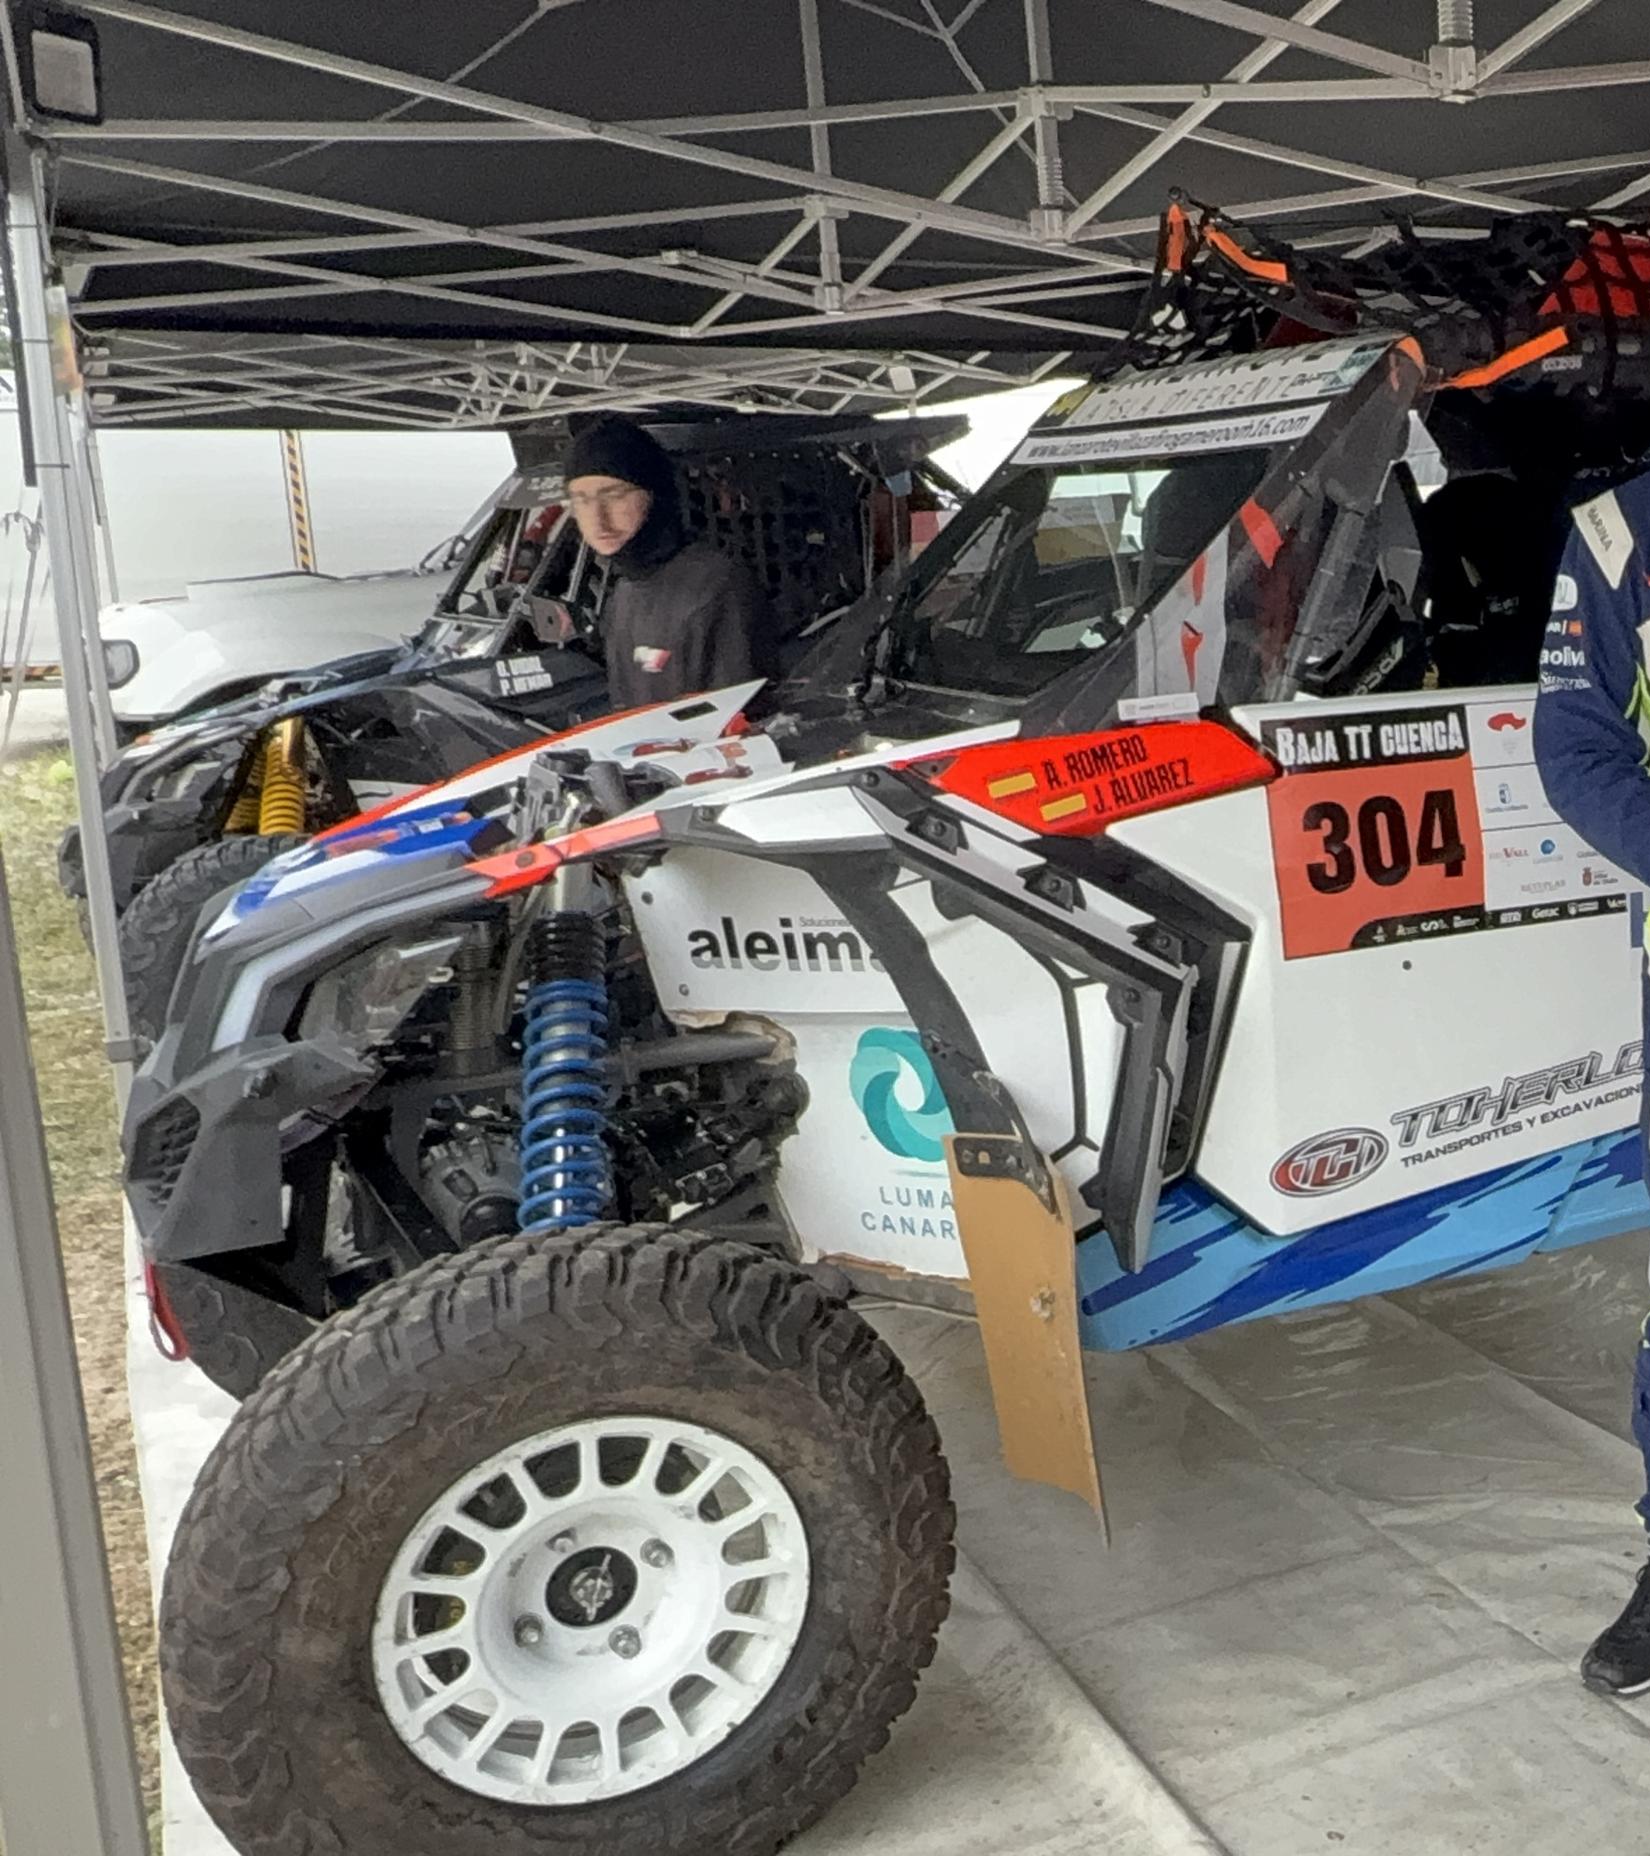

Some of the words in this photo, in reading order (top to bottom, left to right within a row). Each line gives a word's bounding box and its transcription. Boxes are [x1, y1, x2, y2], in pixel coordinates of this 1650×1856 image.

[1044, 759, 1067, 790] A.
[1063, 734, 1148, 784] ROMERO
[1276, 727, 1340, 766] BAJA
[1344, 724, 1374, 761] TT
[1380, 712, 1465, 757] CUENCA
[1093, 784, 1113, 815] J.
[1303, 788, 1467, 894] 304
[1401, 1119, 1524, 1169] TRANSPORTES
[1526, 1116, 1537, 1128] Y
[861, 1211, 957, 1240] CANAR
